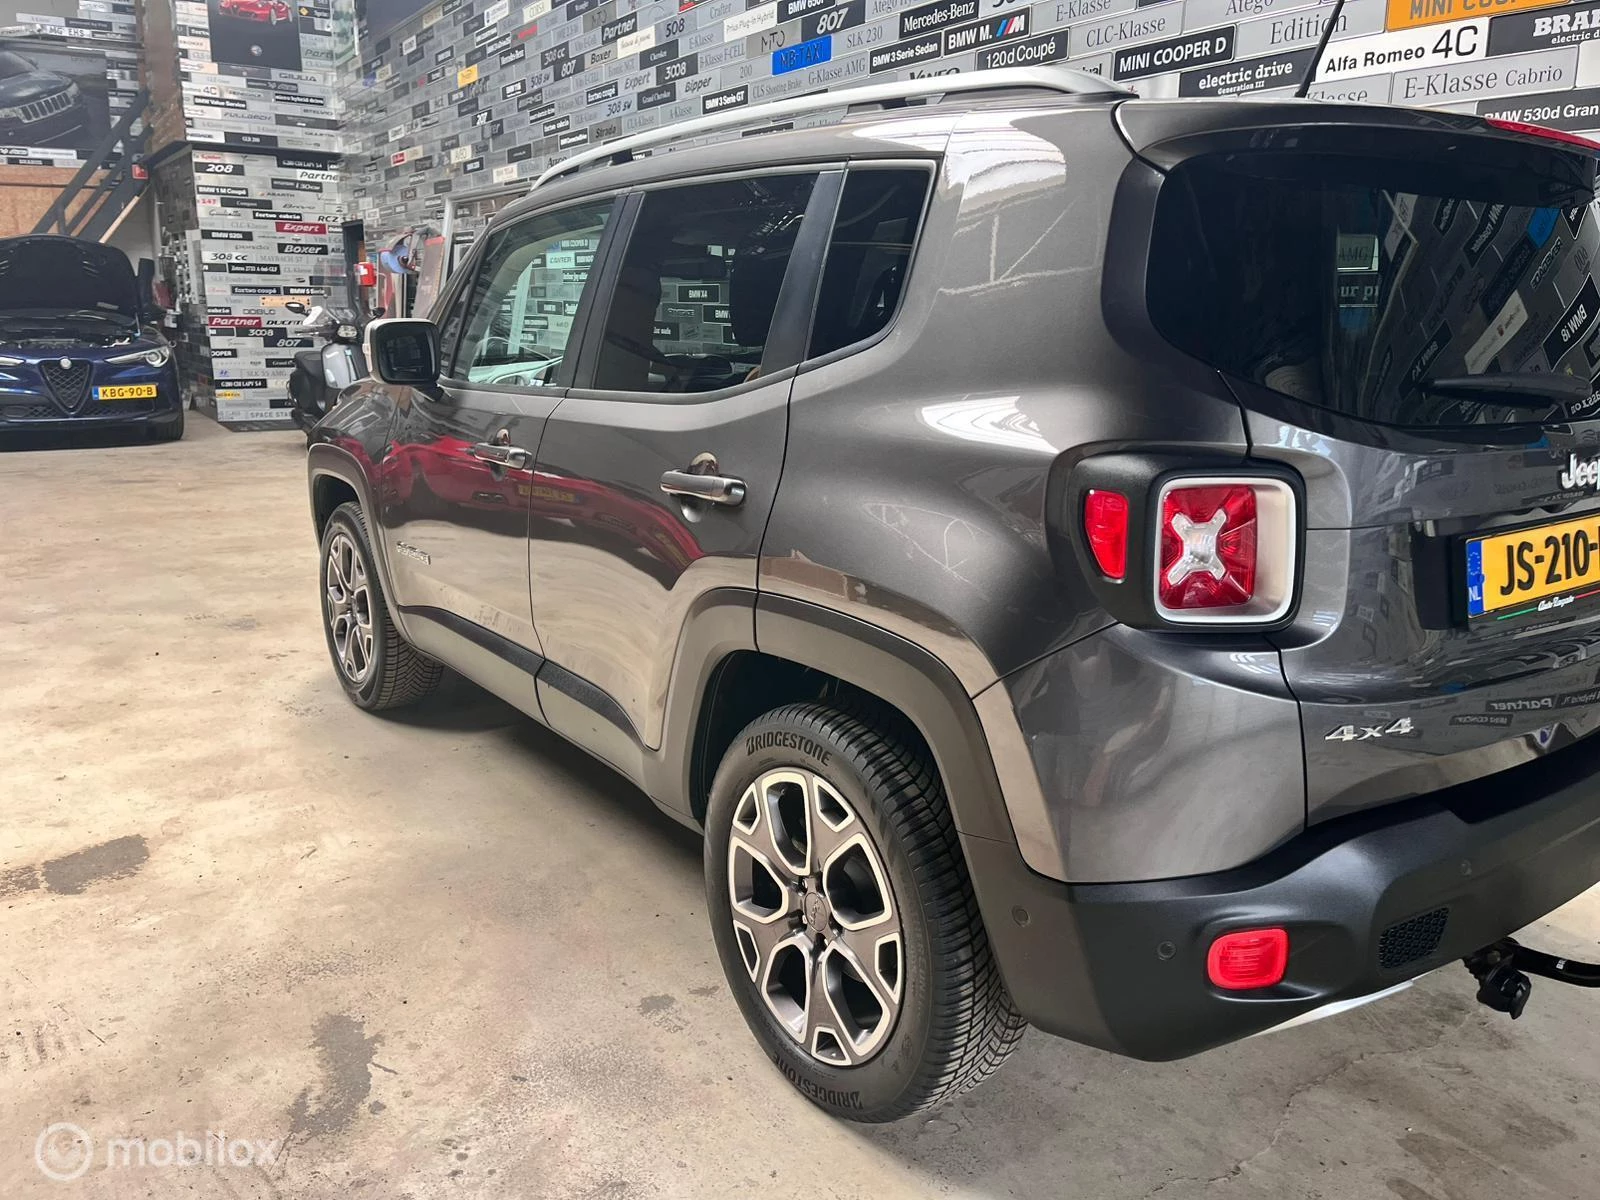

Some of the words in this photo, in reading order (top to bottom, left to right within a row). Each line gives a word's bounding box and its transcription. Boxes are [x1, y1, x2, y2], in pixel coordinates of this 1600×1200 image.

[788, 1, 807, 15] BMW
[903, 1, 975, 33] Mercedes-Benz
[1409, 0, 1453, 20] MINI
[603, 18, 636, 41] Partner
[817, 7, 849, 35] 807
[846, 35, 864, 49] SLK
[866, 26, 883, 43] 230
[948, 31, 976, 50] BMW
[1085, 17, 1167, 48] CLC-Klasse
[1551, 31, 1590, 45] electric
[872, 56, 890, 68] BMW
[896, 48, 914, 61] Serie
[914, 41, 938, 55] Sedan
[985, 49, 1014, 69] 120d
[1015, 36, 1056, 62] Coupé
[1119, 52, 1151, 73] MINI
[1153, 39, 1211, 67] COOPER
[1214, 36, 1227, 54] D
[1325, 57, 1358, 74] Alfa
[1364, 48, 1425, 67] Romeo
[1432, 26, 1478, 59] 4C
[561, 60, 577, 78] 807
[664, 63, 688, 80] 3008
[844, 57, 866, 76] AMG
[1199, 69, 1253, 90] electric
[1256, 60, 1294, 79] drive
[684, 78, 712, 93] Bipper
[1404, 71, 1498, 99] E-Klasse
[1506, 66, 1563, 87] Cabrio
[1524, 105, 1560, 122] 530d
[1563, 104, 1600, 117] Gran
[206, 164, 233, 173] 208
[283, 223, 320, 233] Expert
[318, 215, 339, 223] RCZ
[284, 245, 322, 254] Boxer
[212, 317, 260, 326] Partner
[248, 329, 274, 338] 3008
[277, 338, 302, 347] 807
[103, 388, 154, 397] KBG-90-B
[1500, 529, 1600, 597] JS-210-
[1468, 586, 1481, 602] NL
[1325, 717, 1414, 742] 4x4
[746, 735, 833, 767] BRIDGESTONE
[772, 1054, 863, 1111] BRIDGESTONE
